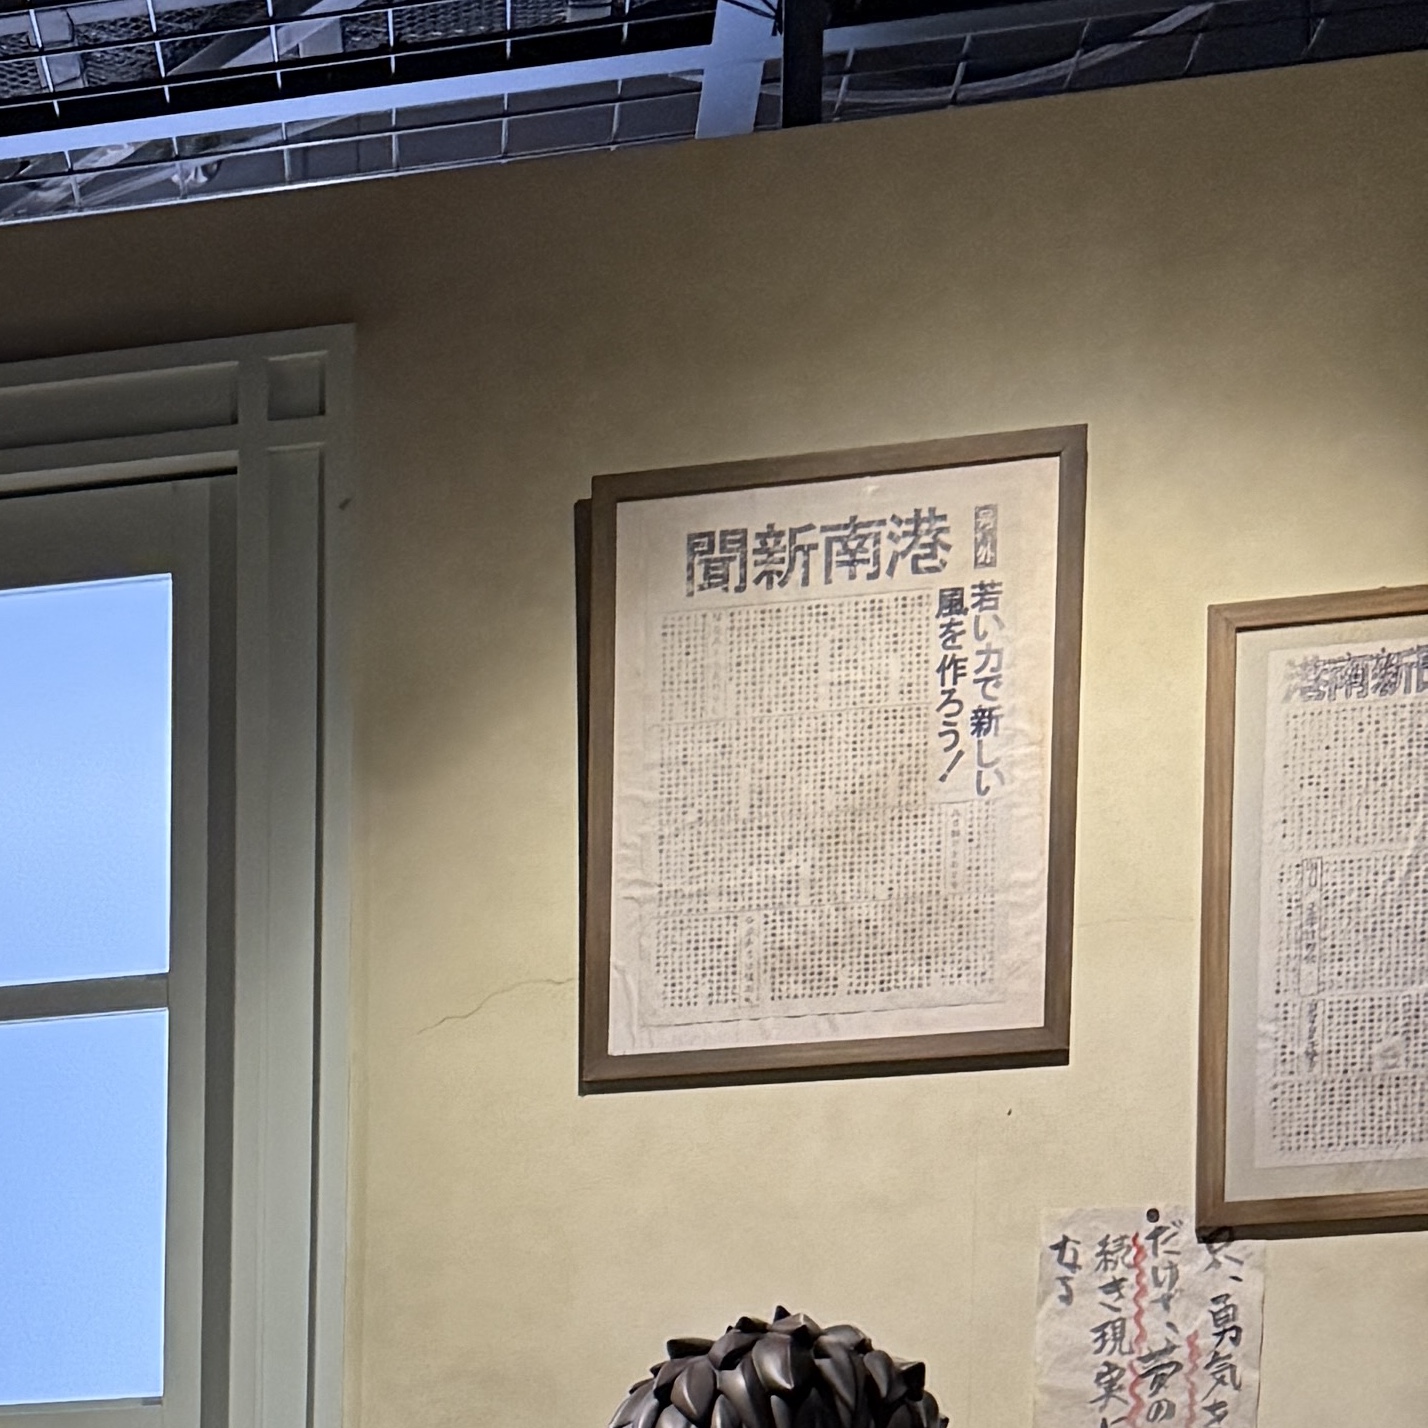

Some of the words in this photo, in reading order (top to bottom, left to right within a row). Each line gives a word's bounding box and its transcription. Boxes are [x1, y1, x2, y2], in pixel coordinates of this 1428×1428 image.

[935, 586, 969, 783] 風を作ろう!
[970, 579, 1005, 797] 若い力で新しい
[1049, 1234, 1082, 1306] なる
